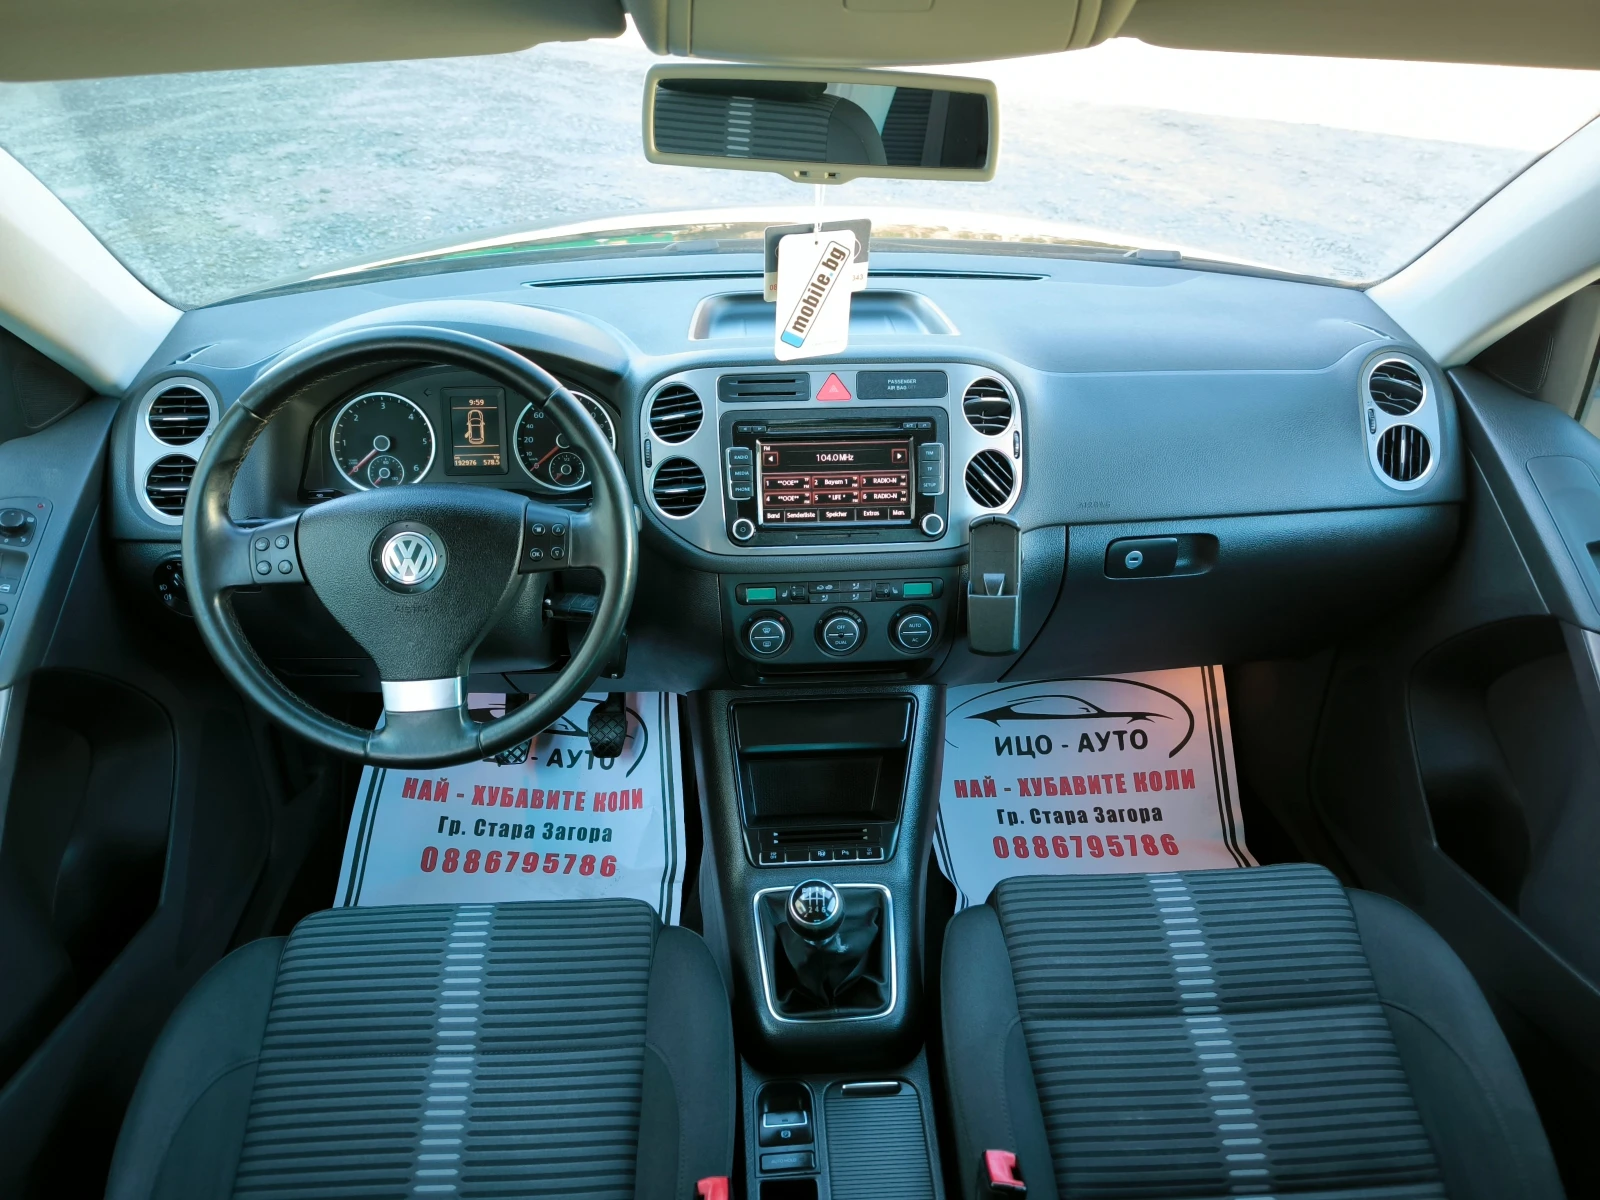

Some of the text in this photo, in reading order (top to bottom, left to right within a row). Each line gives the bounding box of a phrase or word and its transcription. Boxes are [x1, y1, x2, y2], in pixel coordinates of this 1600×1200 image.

[792, 247, 846, 334] mobile.bg
[384, 534, 435, 583] VW
[994, 734, 1052, 759] ИЦО
[1078, 729, 1149, 752] АУТО
[402, 777, 449, 802] НАЙ
[471, 785, 585, 811] ХУБАВИТЕ
[593, 788, 643, 812] КОЛИ
[954, 775, 997, 798] НАЙ
[1017, 773, 1127, 797] ХУБАВИТЕ
[1133, 768, 1196, 792] КОЛИ
[437, 816, 612, 843] Гр. Стара Загора
[997, 806, 1163, 826] Гр. Стара Загора
[992, 833, 1180, 859] 0886795786
[420, 846, 617, 877] 0886795786
